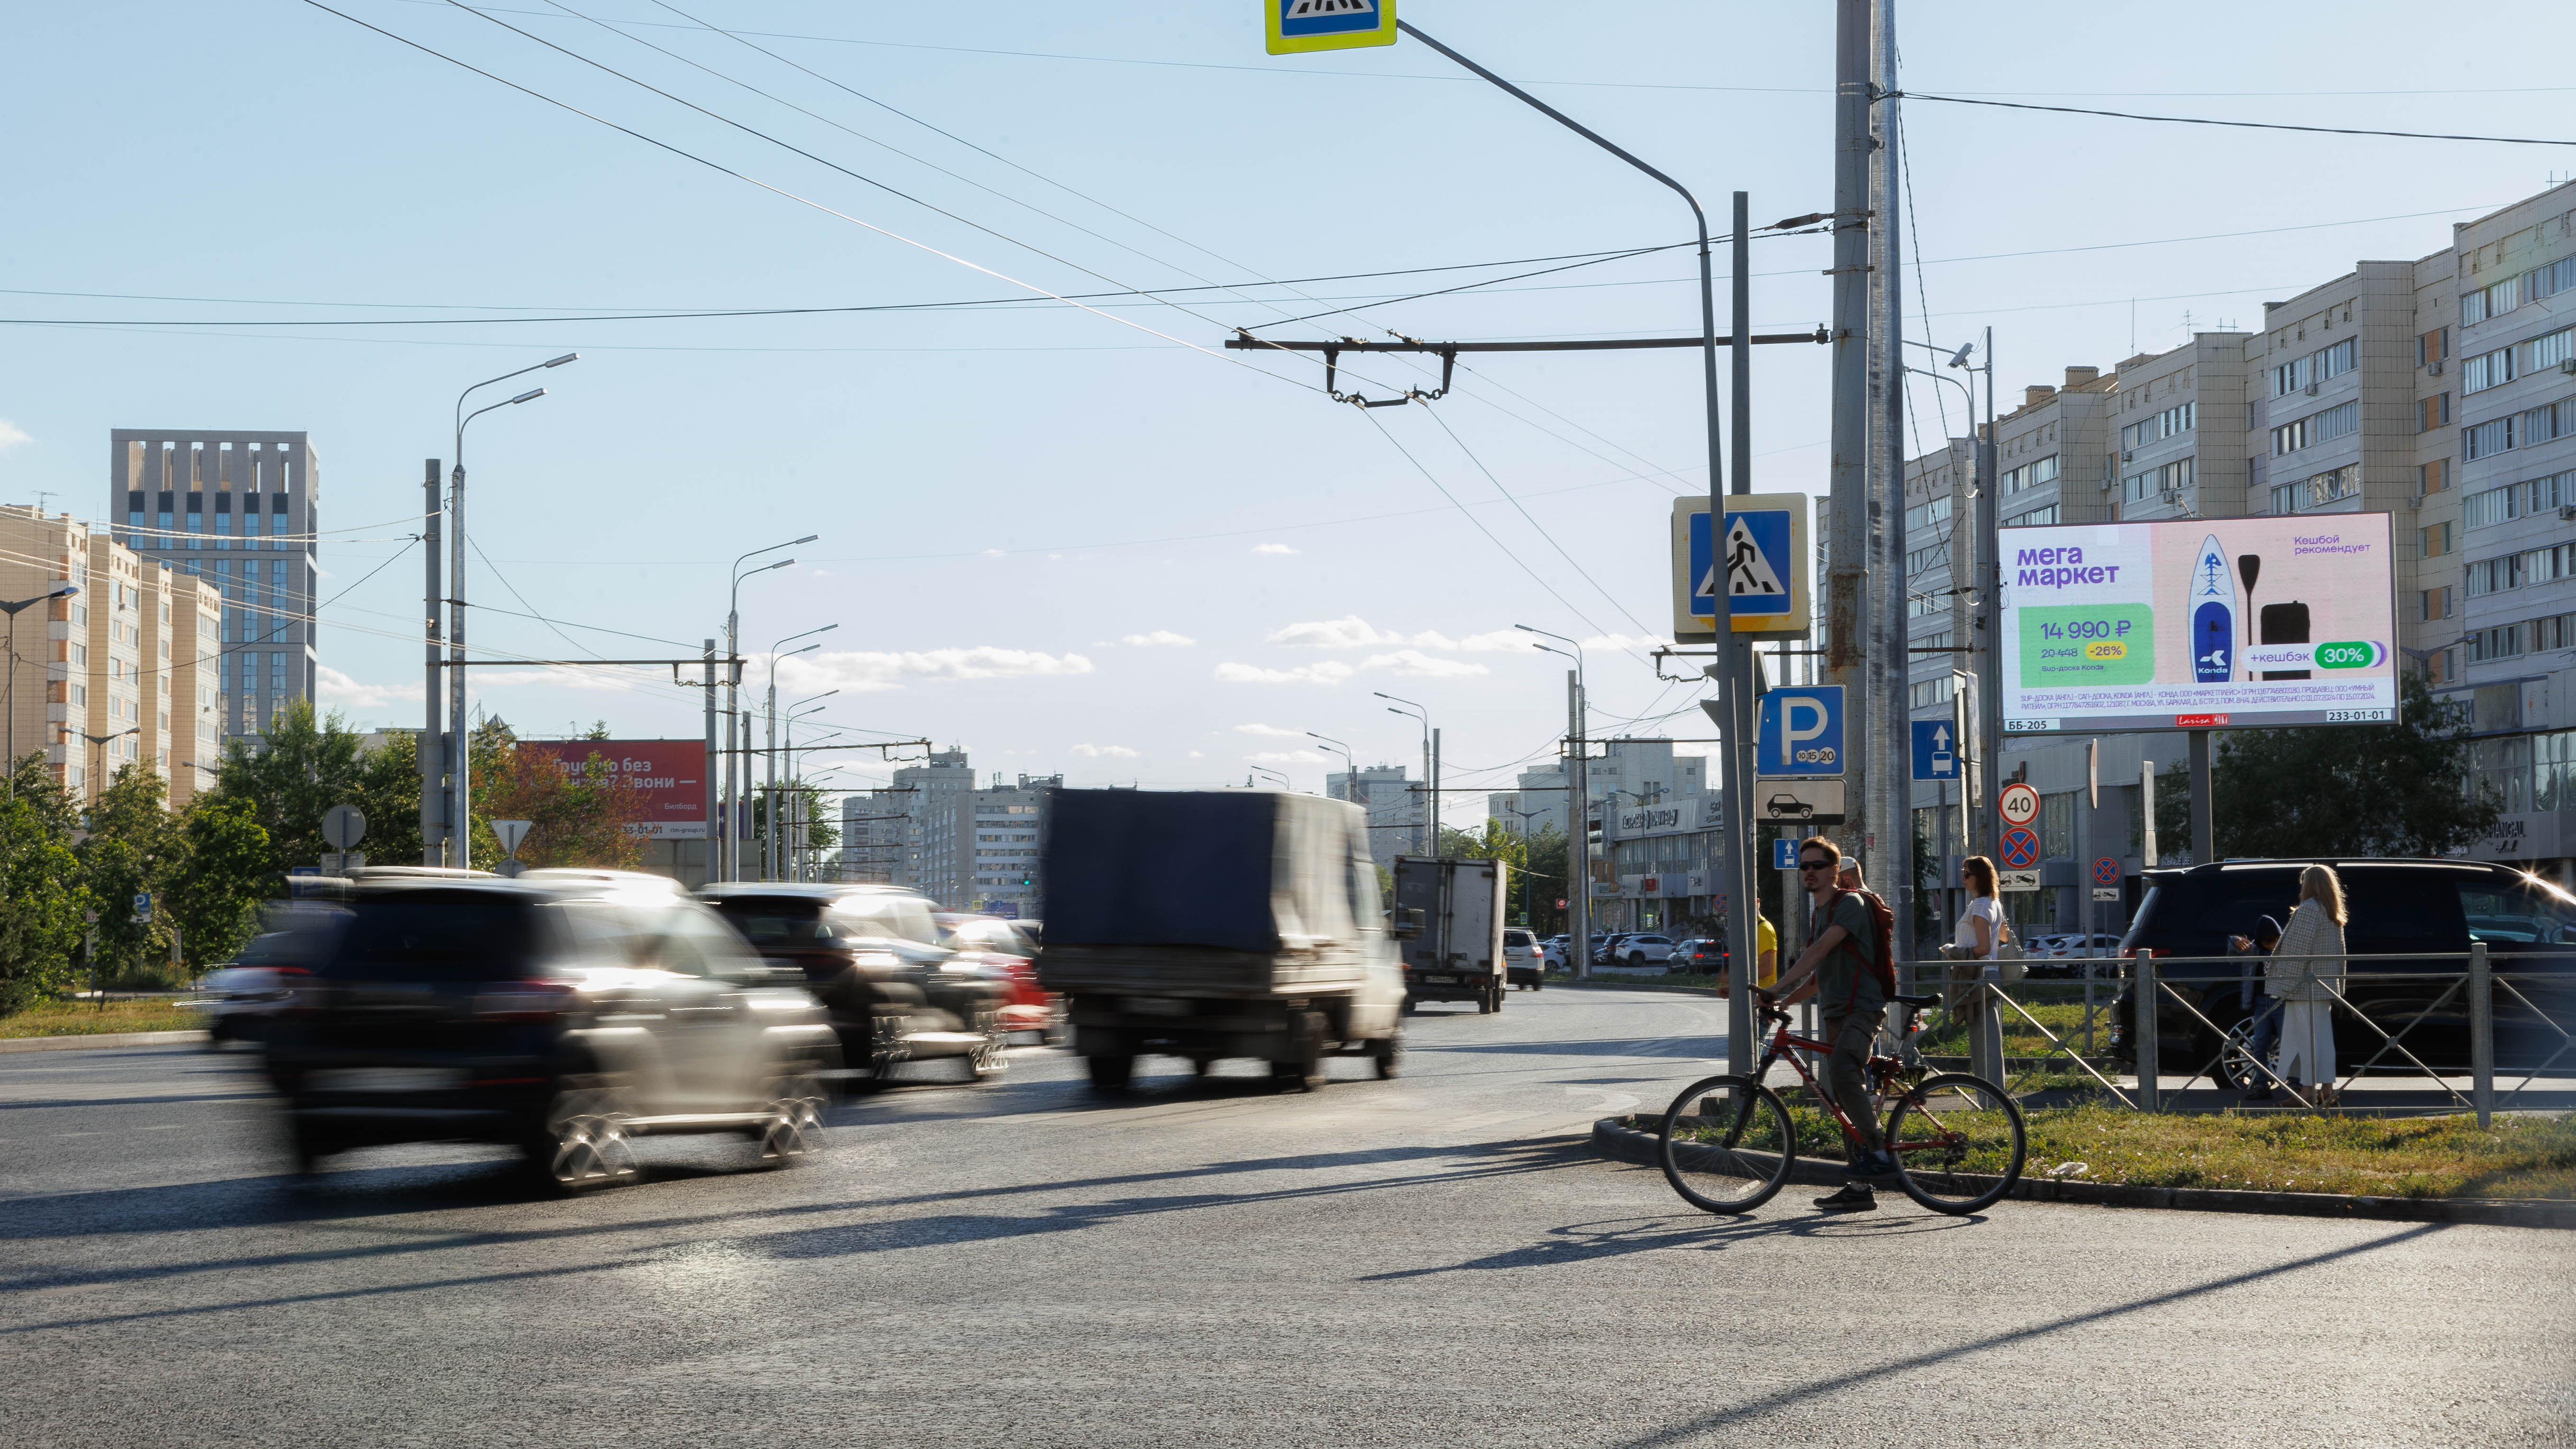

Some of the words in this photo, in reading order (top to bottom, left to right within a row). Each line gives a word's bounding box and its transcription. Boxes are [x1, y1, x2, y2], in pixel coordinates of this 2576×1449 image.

[2294, 535, 2339, 545] Кешбой
[2295, 544, 2371, 556] рекомендует
[2017, 547, 2082, 566] мега
[2018, 566, 2119, 589] маркет
[2041, 623, 2063, 640] 14
[2068, 621, 2109, 639] 990
[2089, 646, 2122, 656] -26%
[2251, 651, 2310, 662] +кешбэк
[2324, 648, 2364, 663] 30%
[2021, 694, 2054, 703] SUP-ДОСКА
[2178, 716, 2210, 725] Larisa
[2329, 710, 2384, 721] 233-01-01
[1781, 697, 1828, 765] P
[2009, 721, 2047, 730] ББ-205
[1820, 751, 1834, 761] 20
[623, 757, 652, 772] без
[2007, 797, 2031, 813] 40
